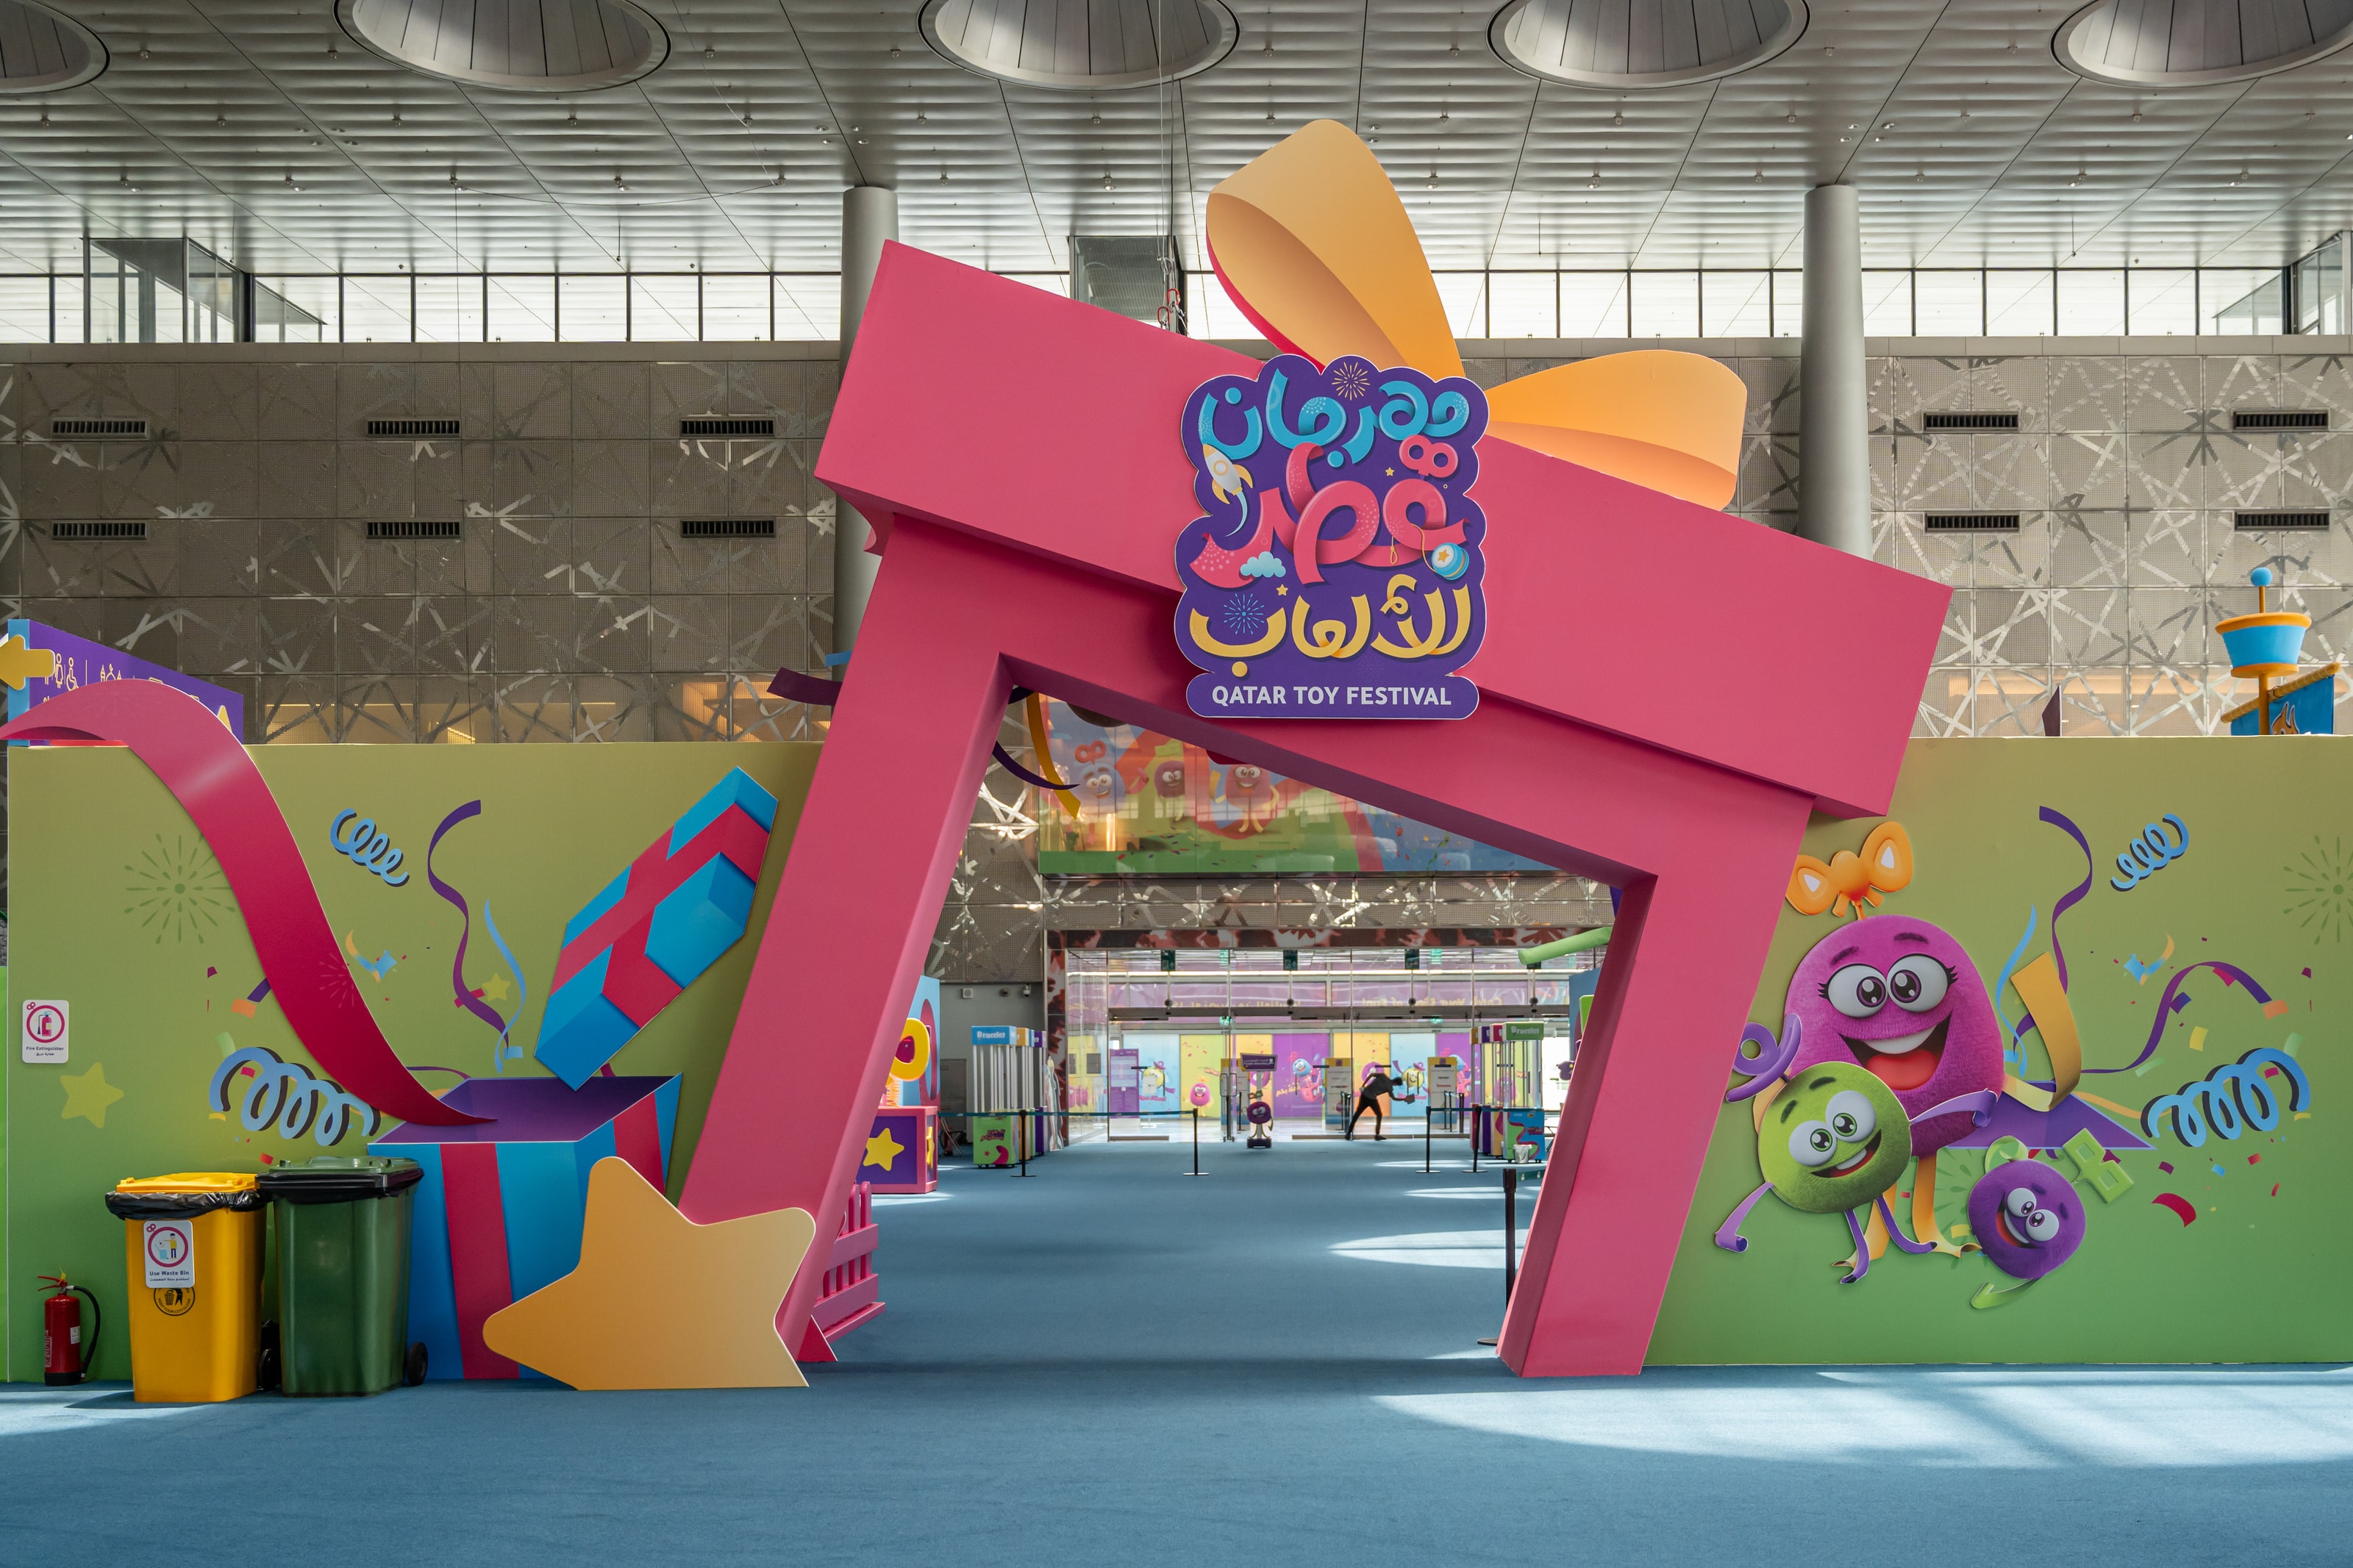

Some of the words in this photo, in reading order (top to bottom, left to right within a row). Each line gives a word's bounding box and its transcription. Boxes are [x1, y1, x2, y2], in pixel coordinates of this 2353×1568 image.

[1198, 368, 1470, 468] مهرجان
[1190, 434, 1471, 588] قطر
[1189, 573, 1472, 678] للألعاب
[1212, 685, 1286, 707] QATAR
[1293, 686, 1340, 705] TOY
[1346, 687, 1452, 706] FESTIVAL
[976, 1031, 1006, 1039] Bracelet
[1510, 1025, 1540, 1034] Bracelet
